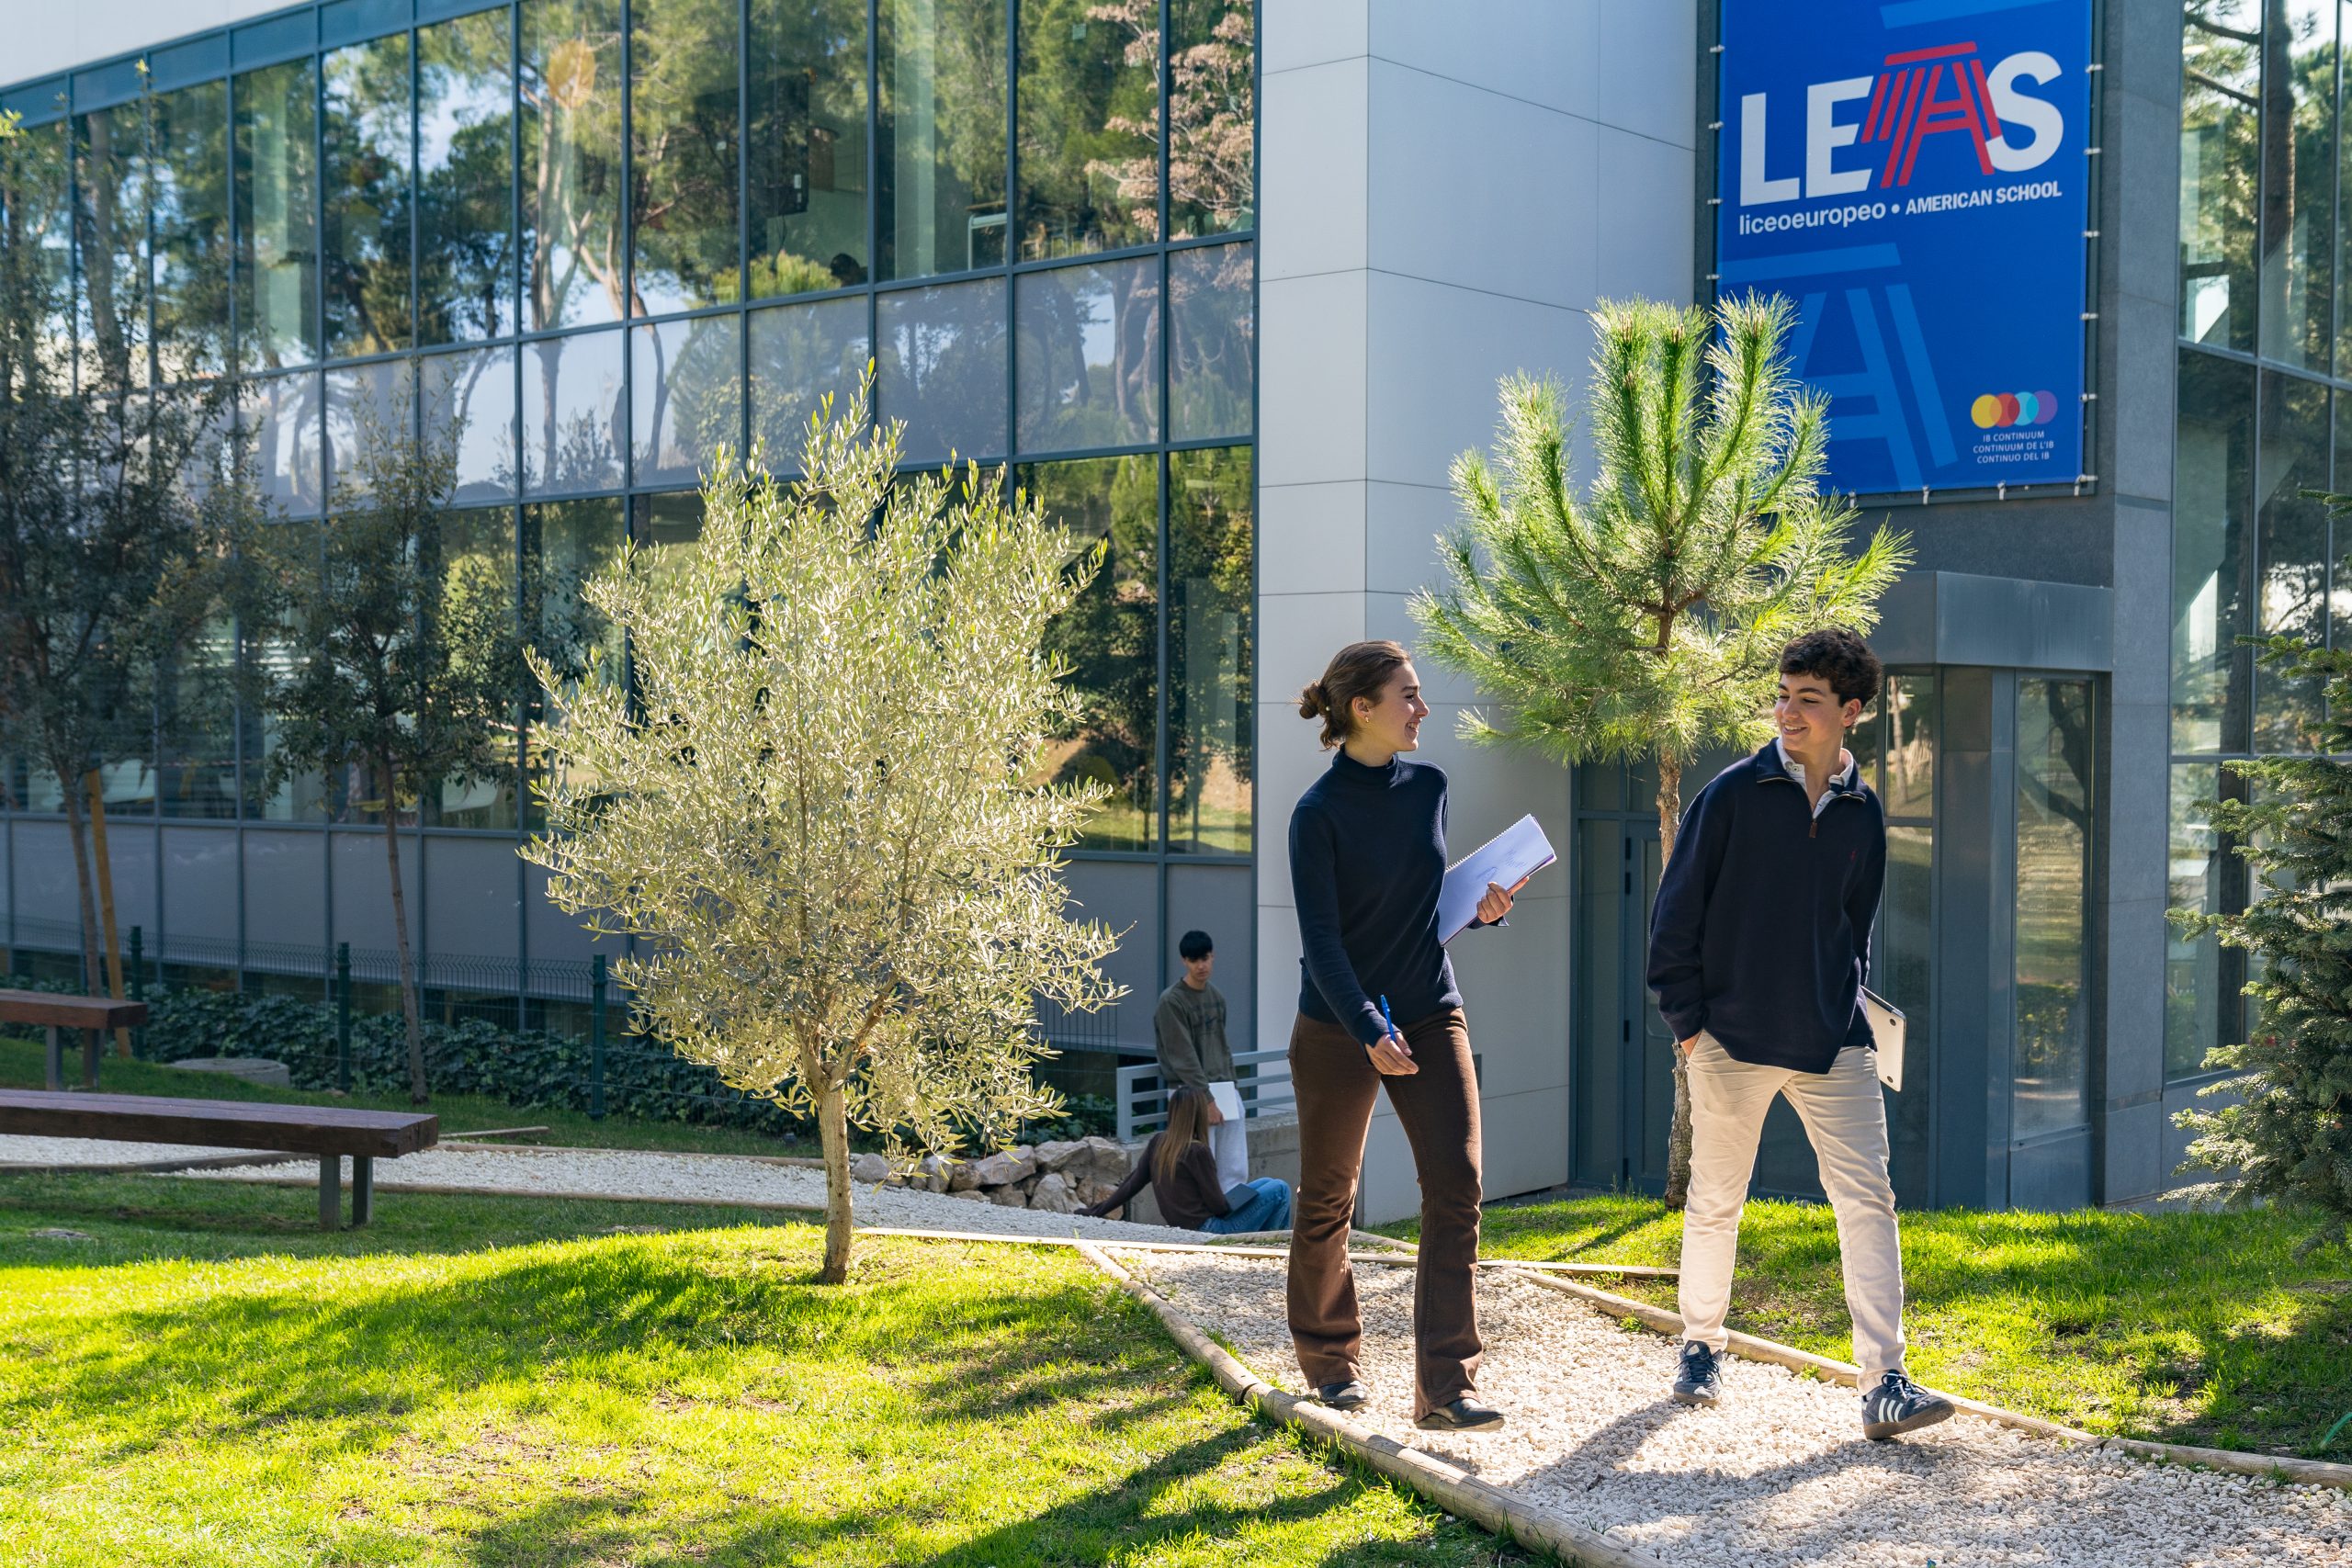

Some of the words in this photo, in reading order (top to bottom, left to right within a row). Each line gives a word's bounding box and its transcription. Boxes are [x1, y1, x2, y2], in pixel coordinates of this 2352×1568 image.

[1741, 41, 2064, 206] LEAS
[1739, 202, 1886, 235] liceoeuropeo
[1905, 189, 1993, 215] AMERICAN
[1996, 181, 2063, 204] SCHOOL
[1983, 434, 1991, 443] IB
[1993, 431, 2044, 442] CONTINUUM
[1973, 444, 2024, 453] CONTINUUM
[2027, 442, 2037, 450] DE
[2040, 441, 2054, 449] L'IB
[1976, 454, 2021, 464] CONTINUO
[2024, 453, 2039, 461] DEL
[2041, 452, 2050, 460] IB
